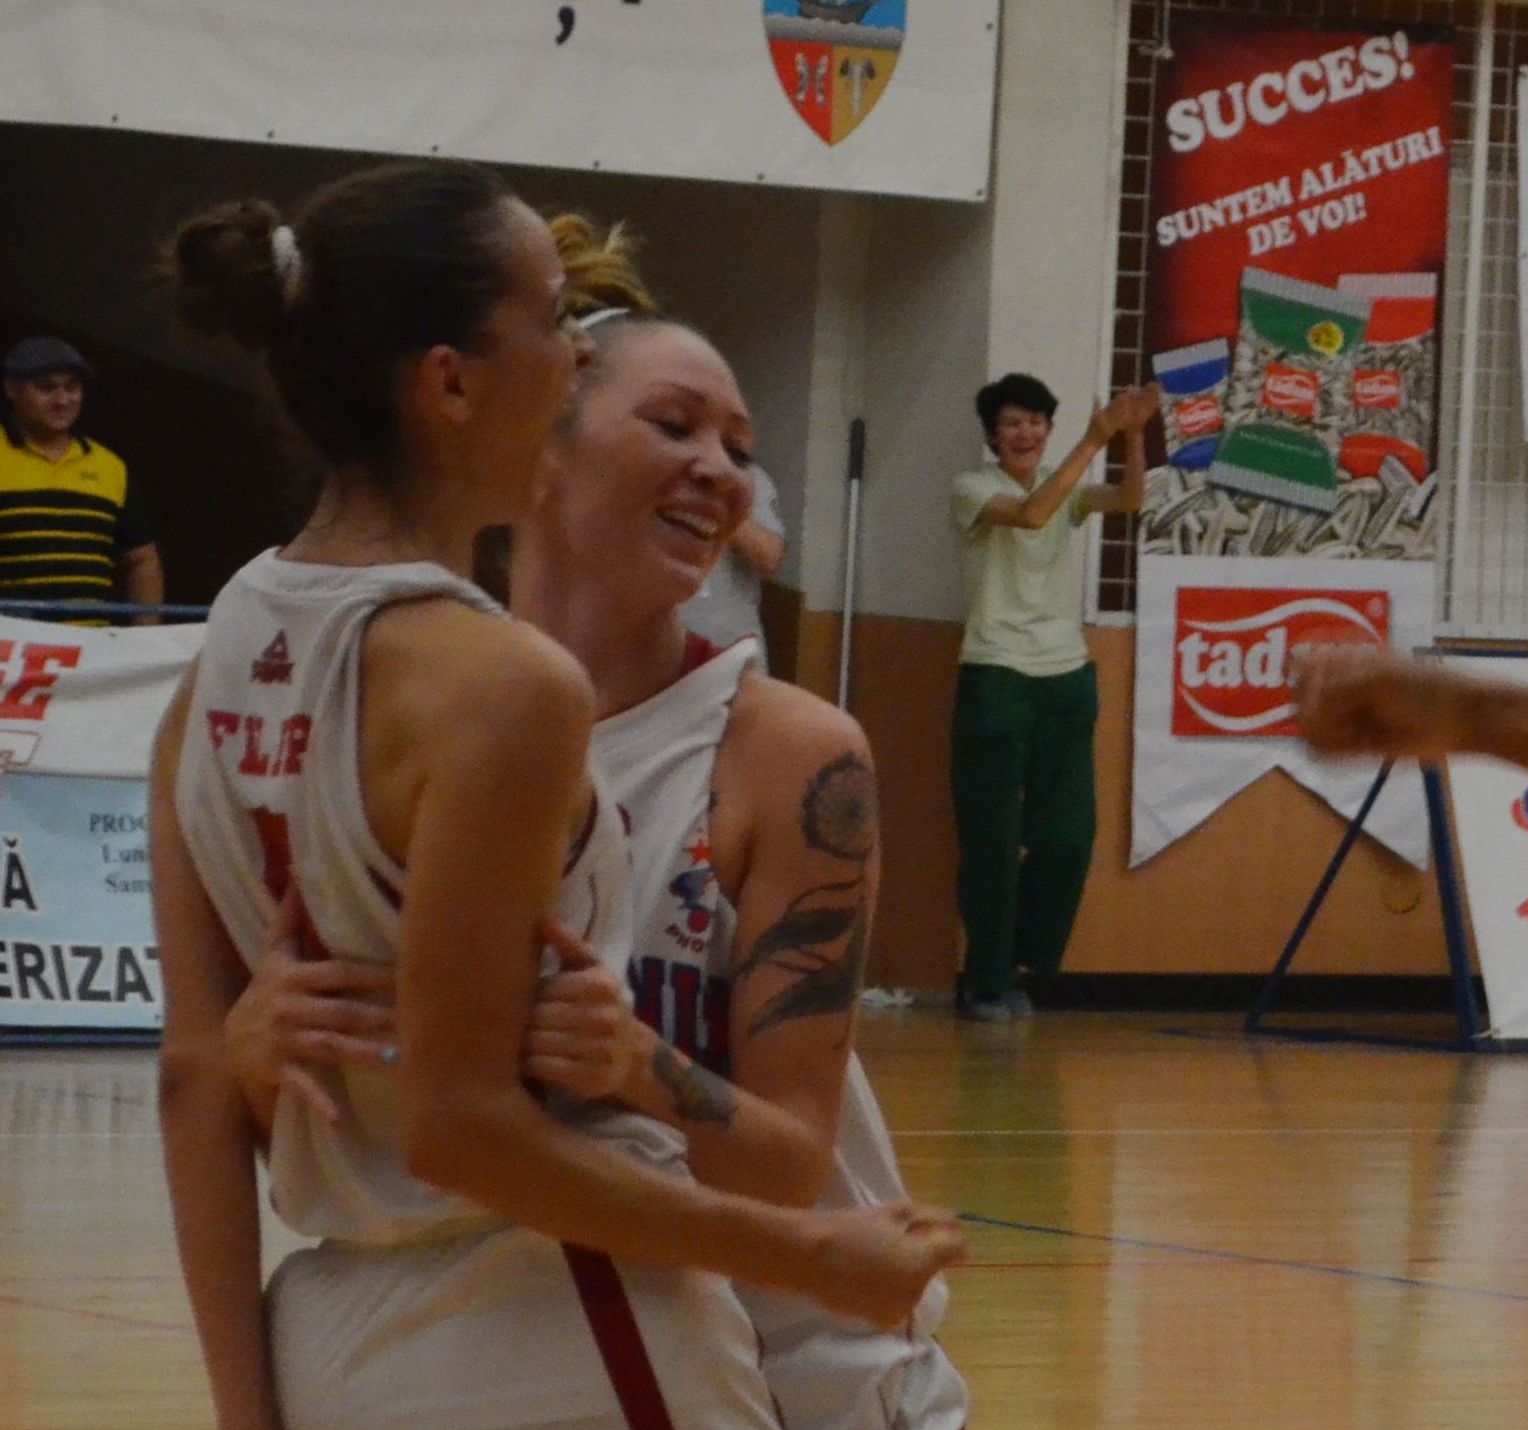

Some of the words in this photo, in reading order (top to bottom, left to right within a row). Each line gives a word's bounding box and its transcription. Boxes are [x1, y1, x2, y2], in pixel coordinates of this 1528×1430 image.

[1166, 30, 1415, 152] SUCCES!
[1156, 176, 1295, 247] SUNTEM
[1299, 126, 1444, 201] ALĂTURI
[1248, 216, 1296, 255] DE
